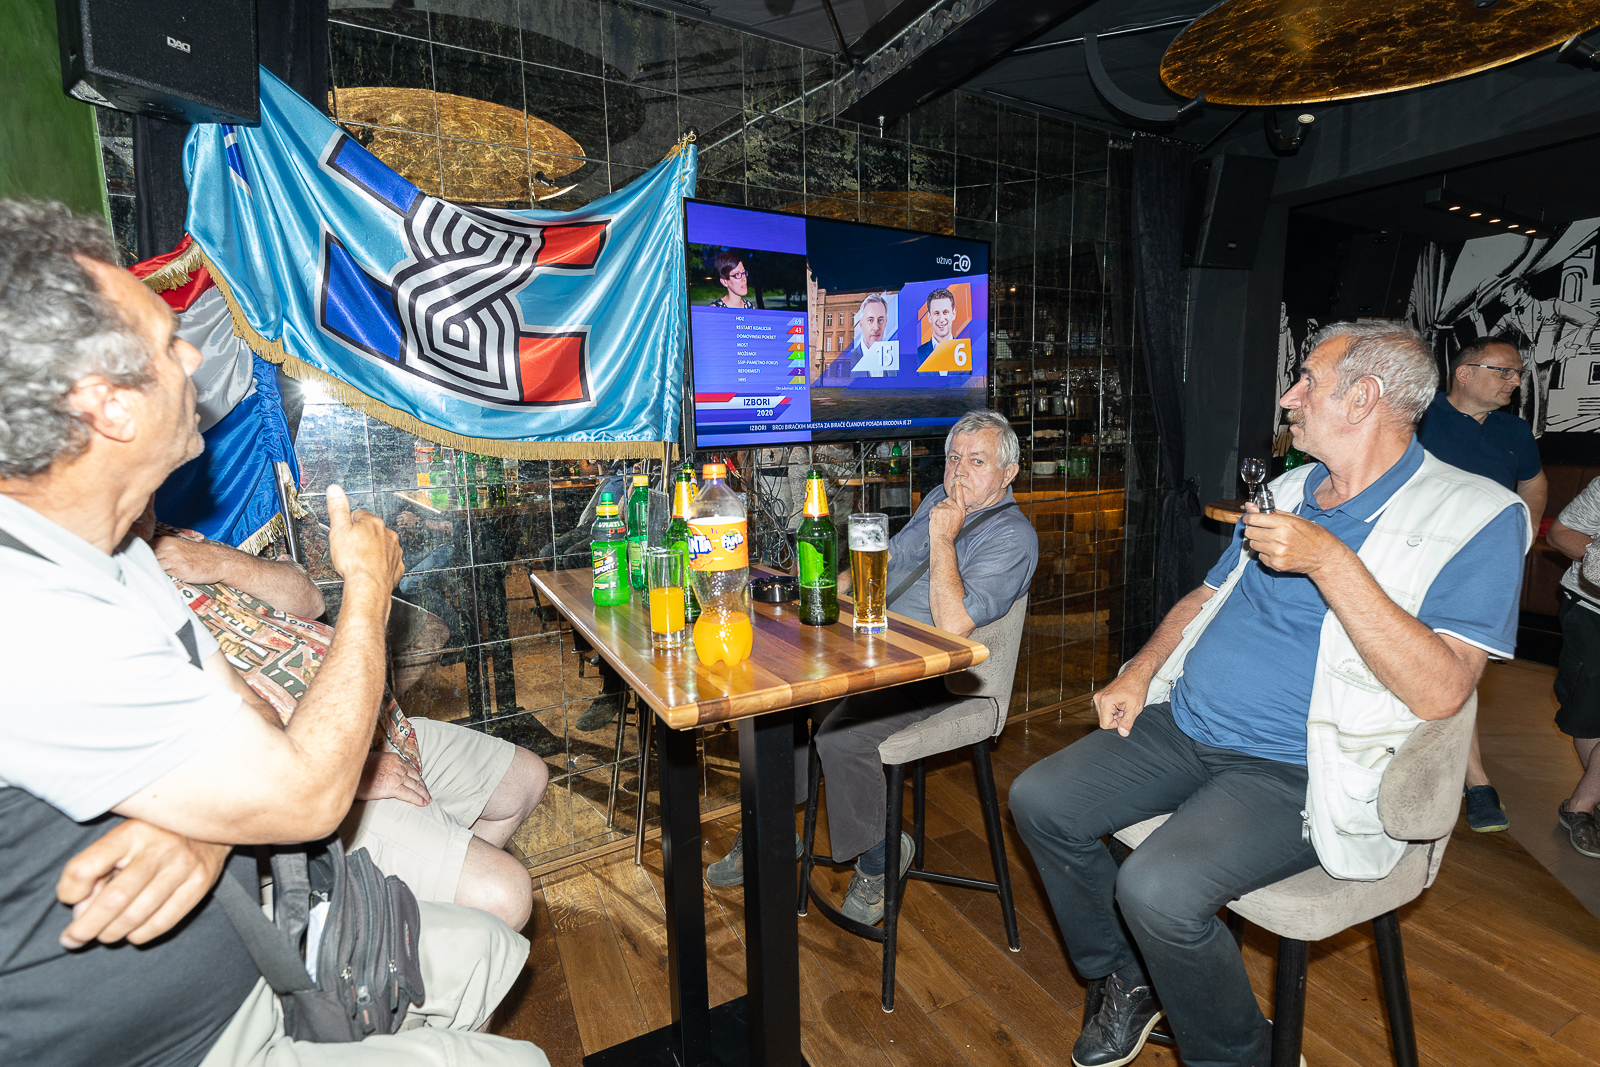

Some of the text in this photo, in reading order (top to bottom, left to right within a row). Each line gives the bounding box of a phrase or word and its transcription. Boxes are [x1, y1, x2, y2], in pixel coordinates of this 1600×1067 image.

[936, 256, 953, 266] UŽIVO
[877, 343, 967, 367] 15 6
[743, 398, 770, 406] IZBORI
[756, 409, 774, 417] 2020
[845, 420, 866, 428] ČLANOVE
[594, 562, 616, 575] SPORT
